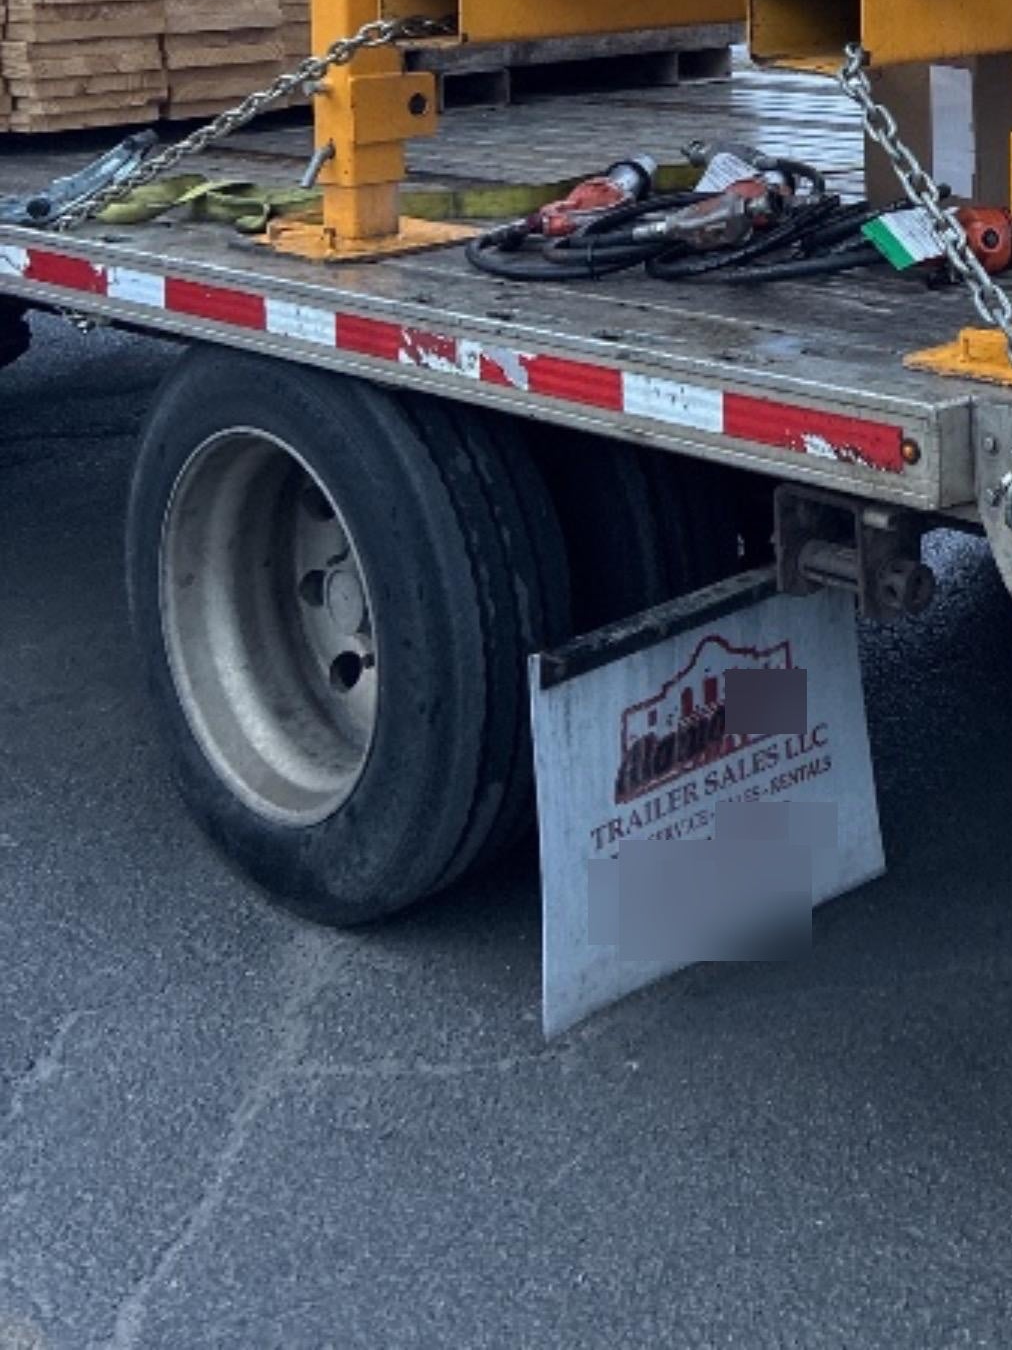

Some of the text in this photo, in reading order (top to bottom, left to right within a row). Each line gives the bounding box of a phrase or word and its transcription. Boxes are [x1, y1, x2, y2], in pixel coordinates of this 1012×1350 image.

[590, 722, 830, 851] TRAILER SALES LLC
[770, 754, 833, 796] RENTALS
